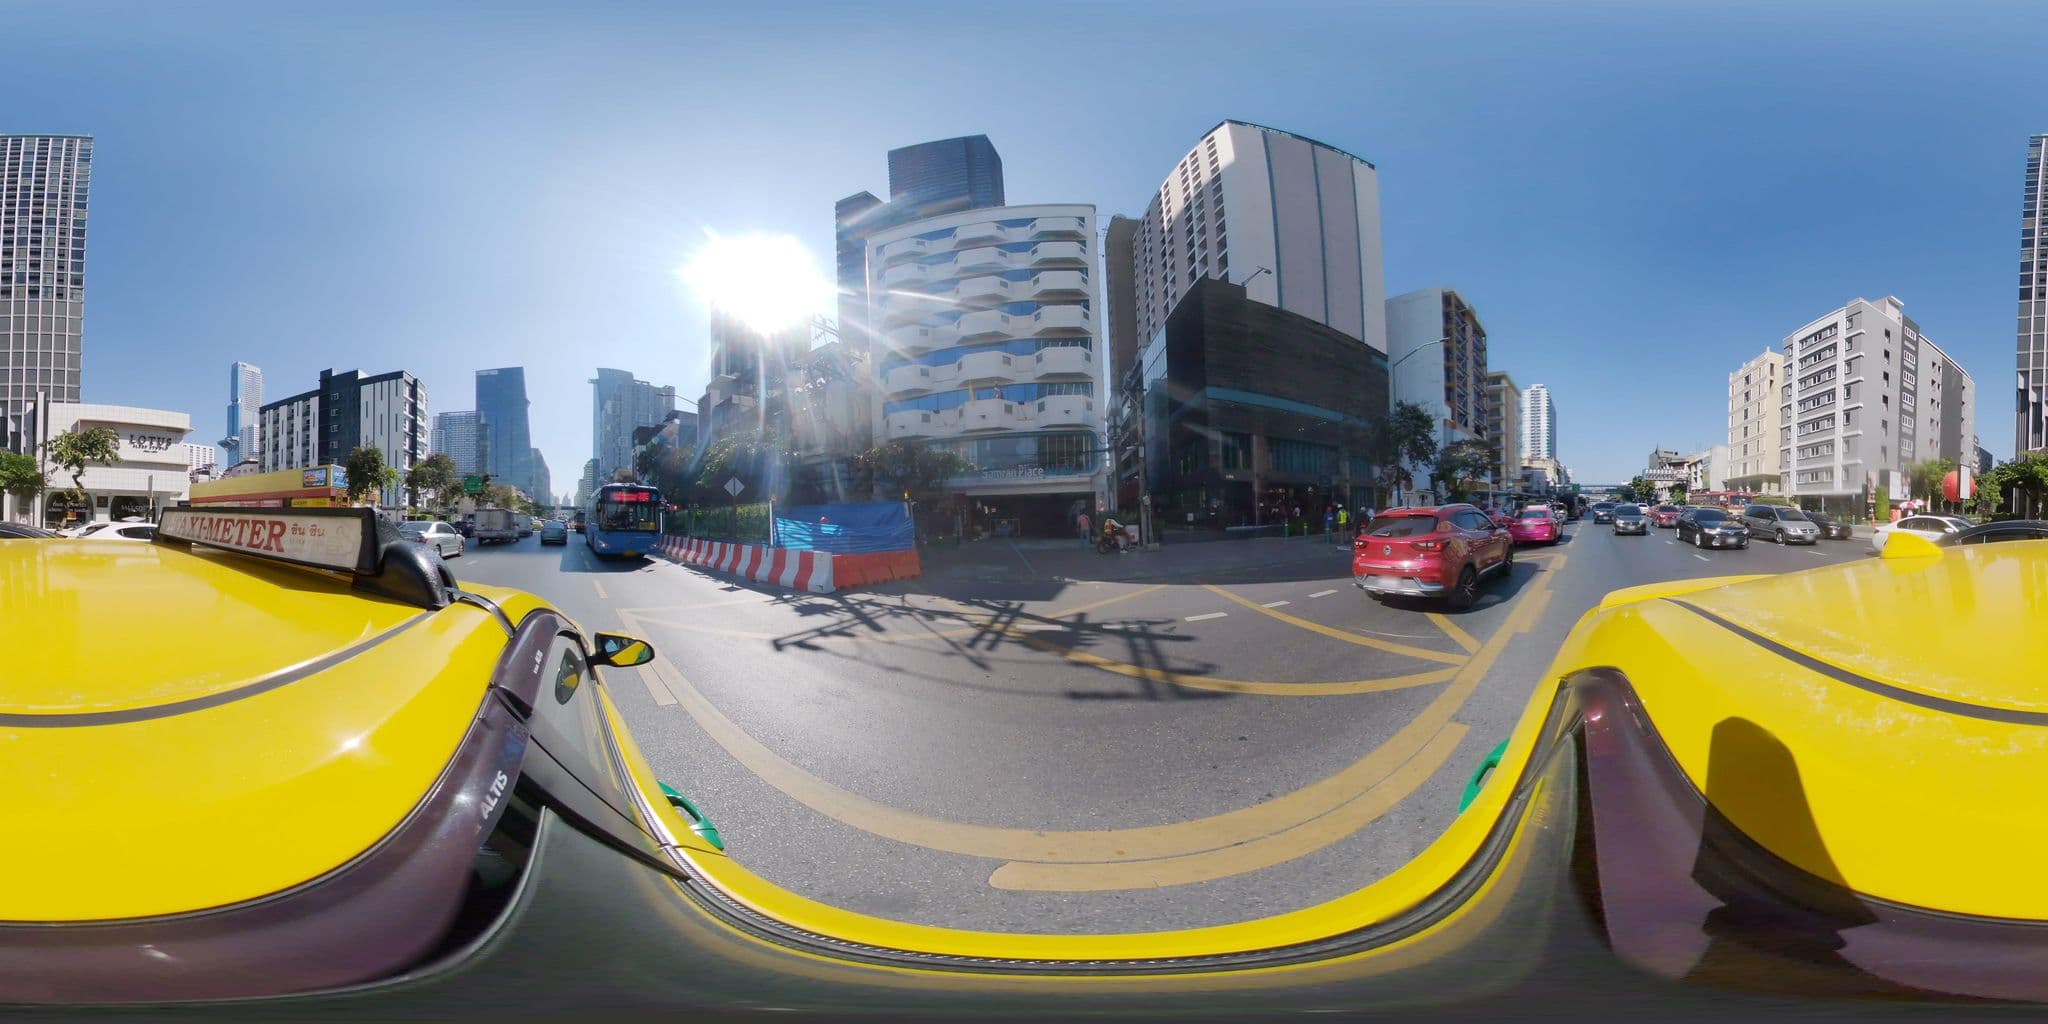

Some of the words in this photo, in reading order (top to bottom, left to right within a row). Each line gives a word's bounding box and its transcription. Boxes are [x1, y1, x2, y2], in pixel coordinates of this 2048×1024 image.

[129, 434, 172, 448] LOTUS
[1018, 464, 1044, 478] Place
[480, 769, 508, 820] ALTIS
